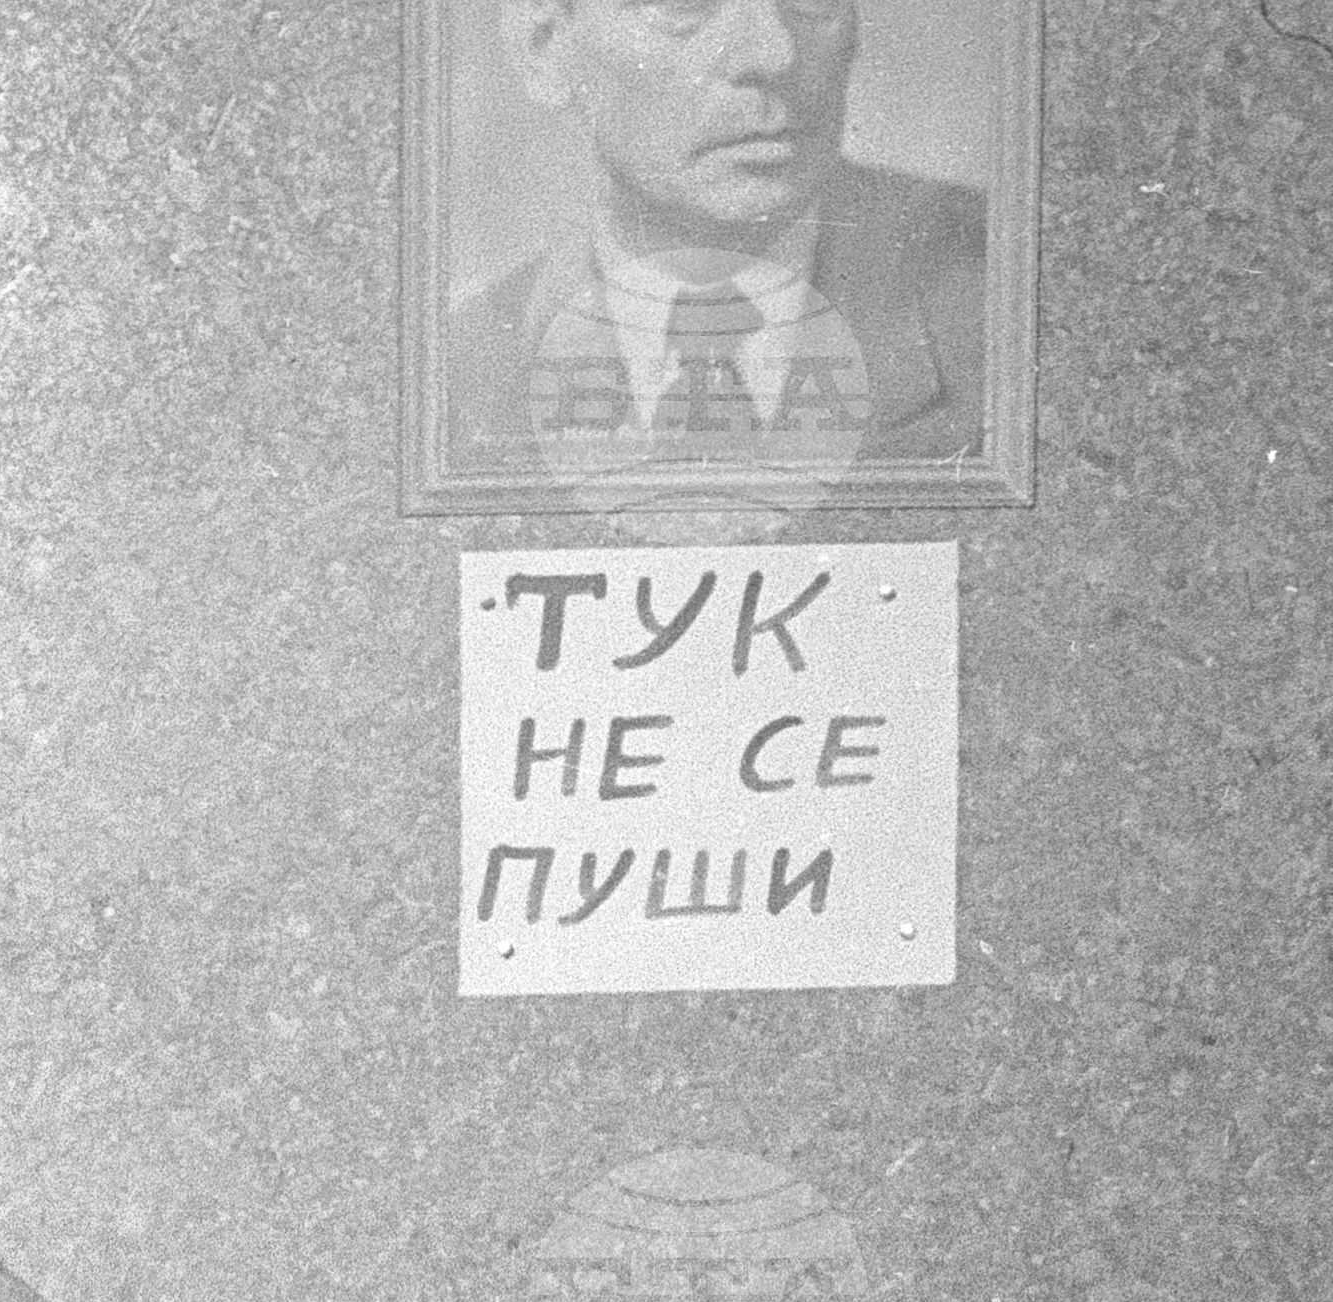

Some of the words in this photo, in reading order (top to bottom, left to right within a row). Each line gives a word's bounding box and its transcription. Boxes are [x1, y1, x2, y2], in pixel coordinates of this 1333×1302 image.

[505, 570, 831, 677] ТУК
[513, 715, 674, 802] НЕ
[739, 714, 887, 793] СЕ
[476, 844, 833, 925] ПУШИ
